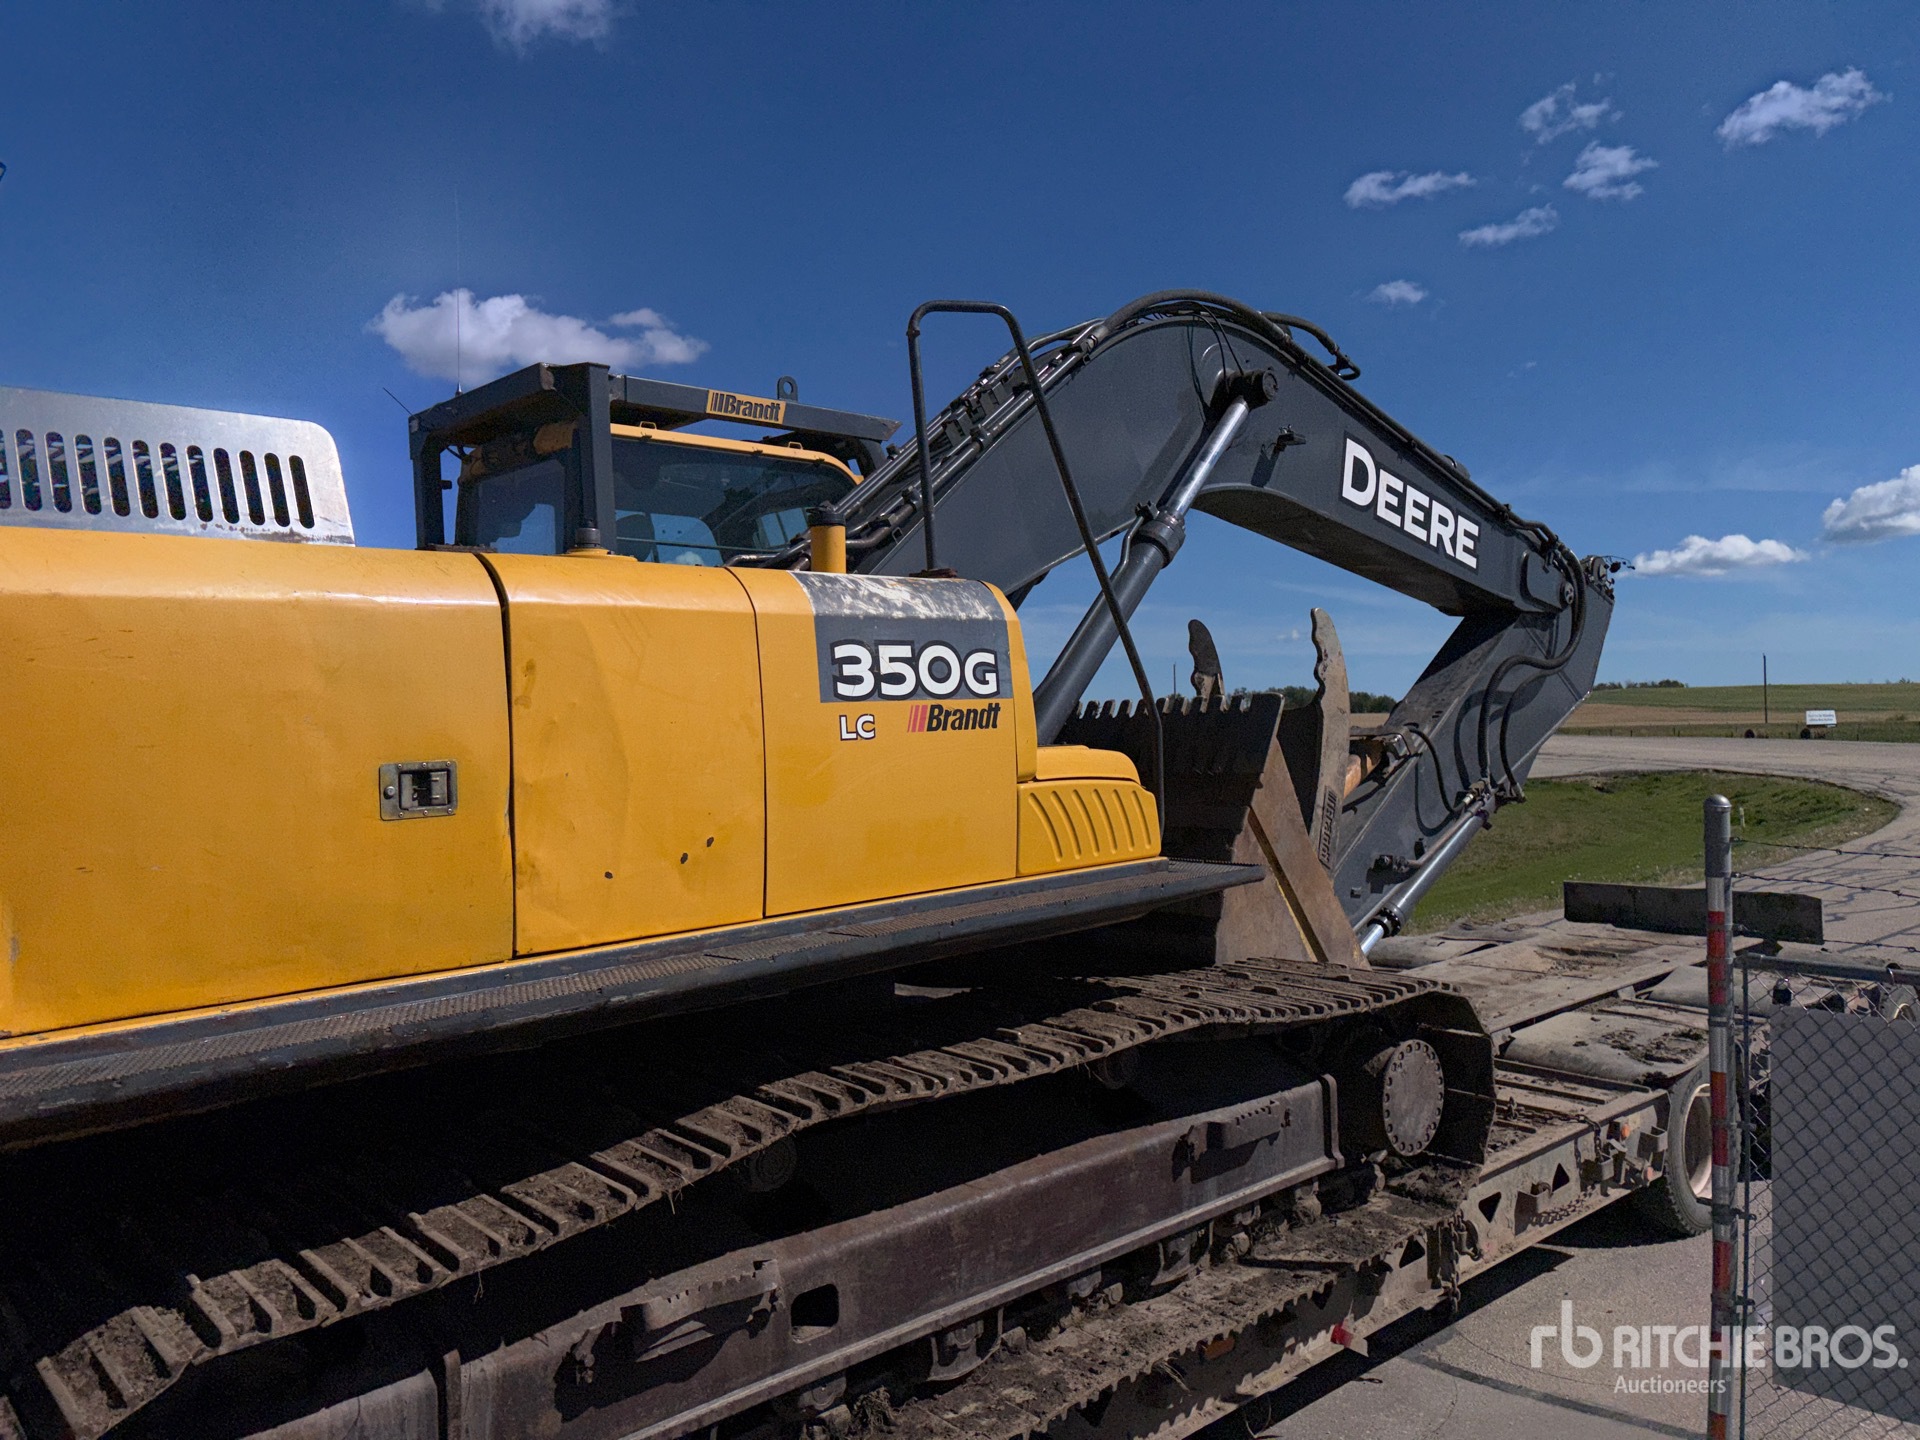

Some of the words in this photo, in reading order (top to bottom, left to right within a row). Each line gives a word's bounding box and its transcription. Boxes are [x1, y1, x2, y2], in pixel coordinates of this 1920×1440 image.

[725, 394, 781, 421] Brandt
[1342, 437, 1479, 569] DEERE
[831, 640, 1000, 699] 350G
[838, 713, 876, 741] LC
[926, 703, 1001, 732] Brandt
